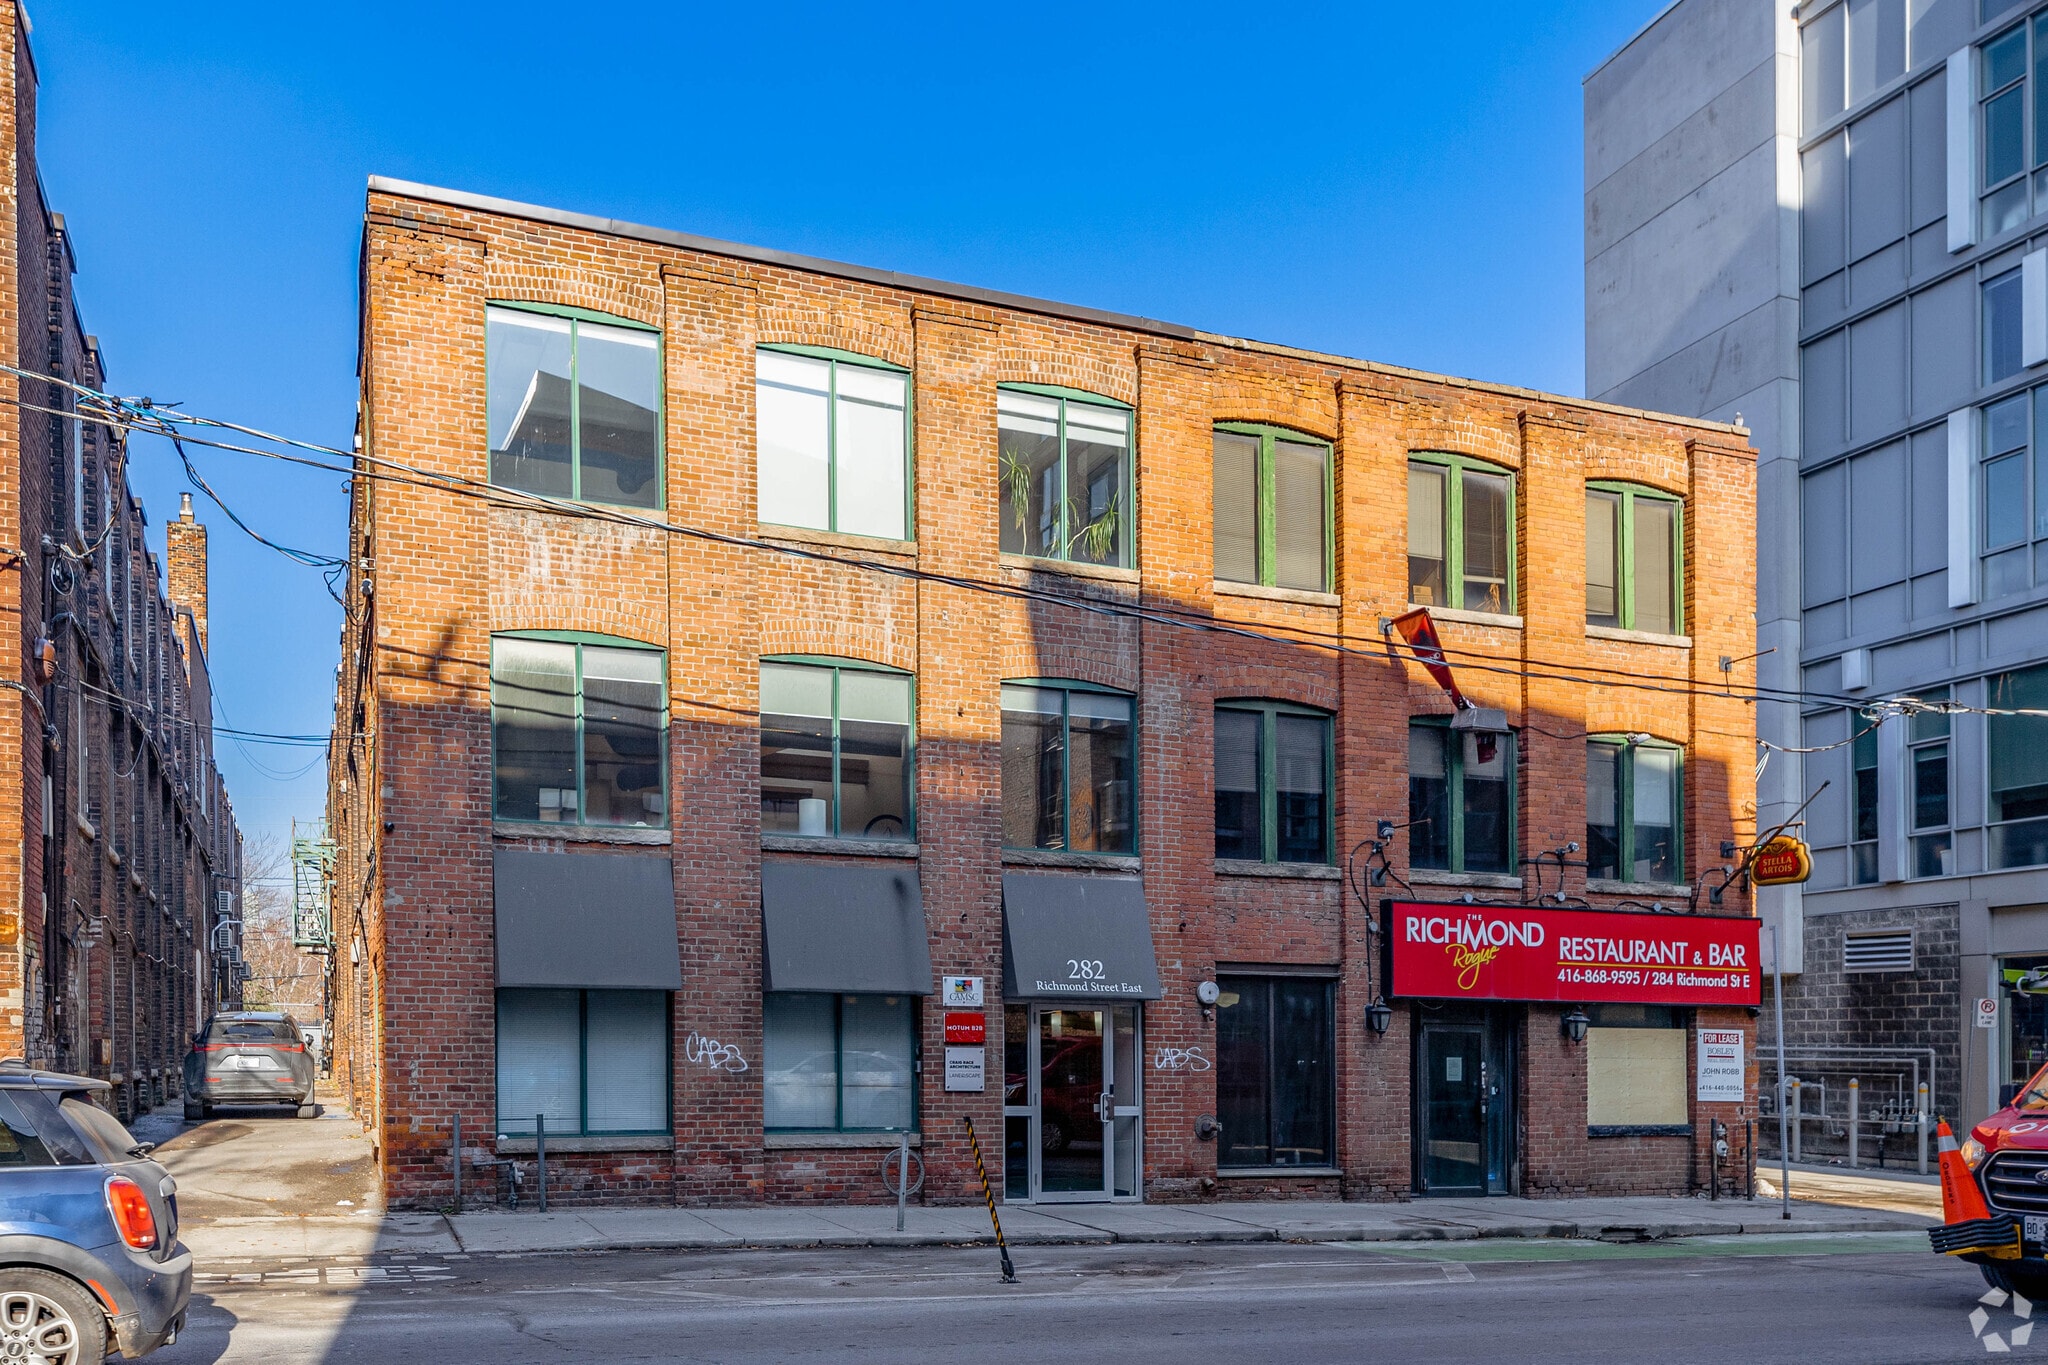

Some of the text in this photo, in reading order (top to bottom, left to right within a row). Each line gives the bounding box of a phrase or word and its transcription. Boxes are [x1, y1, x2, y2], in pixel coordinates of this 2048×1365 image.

[1762, 856, 1793, 867] STELLA
[1762, 864, 1793, 875] ARTOIS
[1467, 913, 1482, 921] THE
[1406, 916, 1545, 952] RICHMOND
[1559, 936, 1747, 967] RESTAURANT & BAR
[1066, 959, 1106, 980] 282
[1445, 943, 1500, 990] Rogue
[1557, 968, 1750, 988] 416-868-9595 / 284 Richmond St E
[1036, 980, 1143, 993] Richmond Street East
[1704, 1034, 1738, 1044] FOR LEASE
[1707, 1047, 1735, 1055] BOSLEY
[1702, 1067, 1740, 1076] JOHN ROBB
